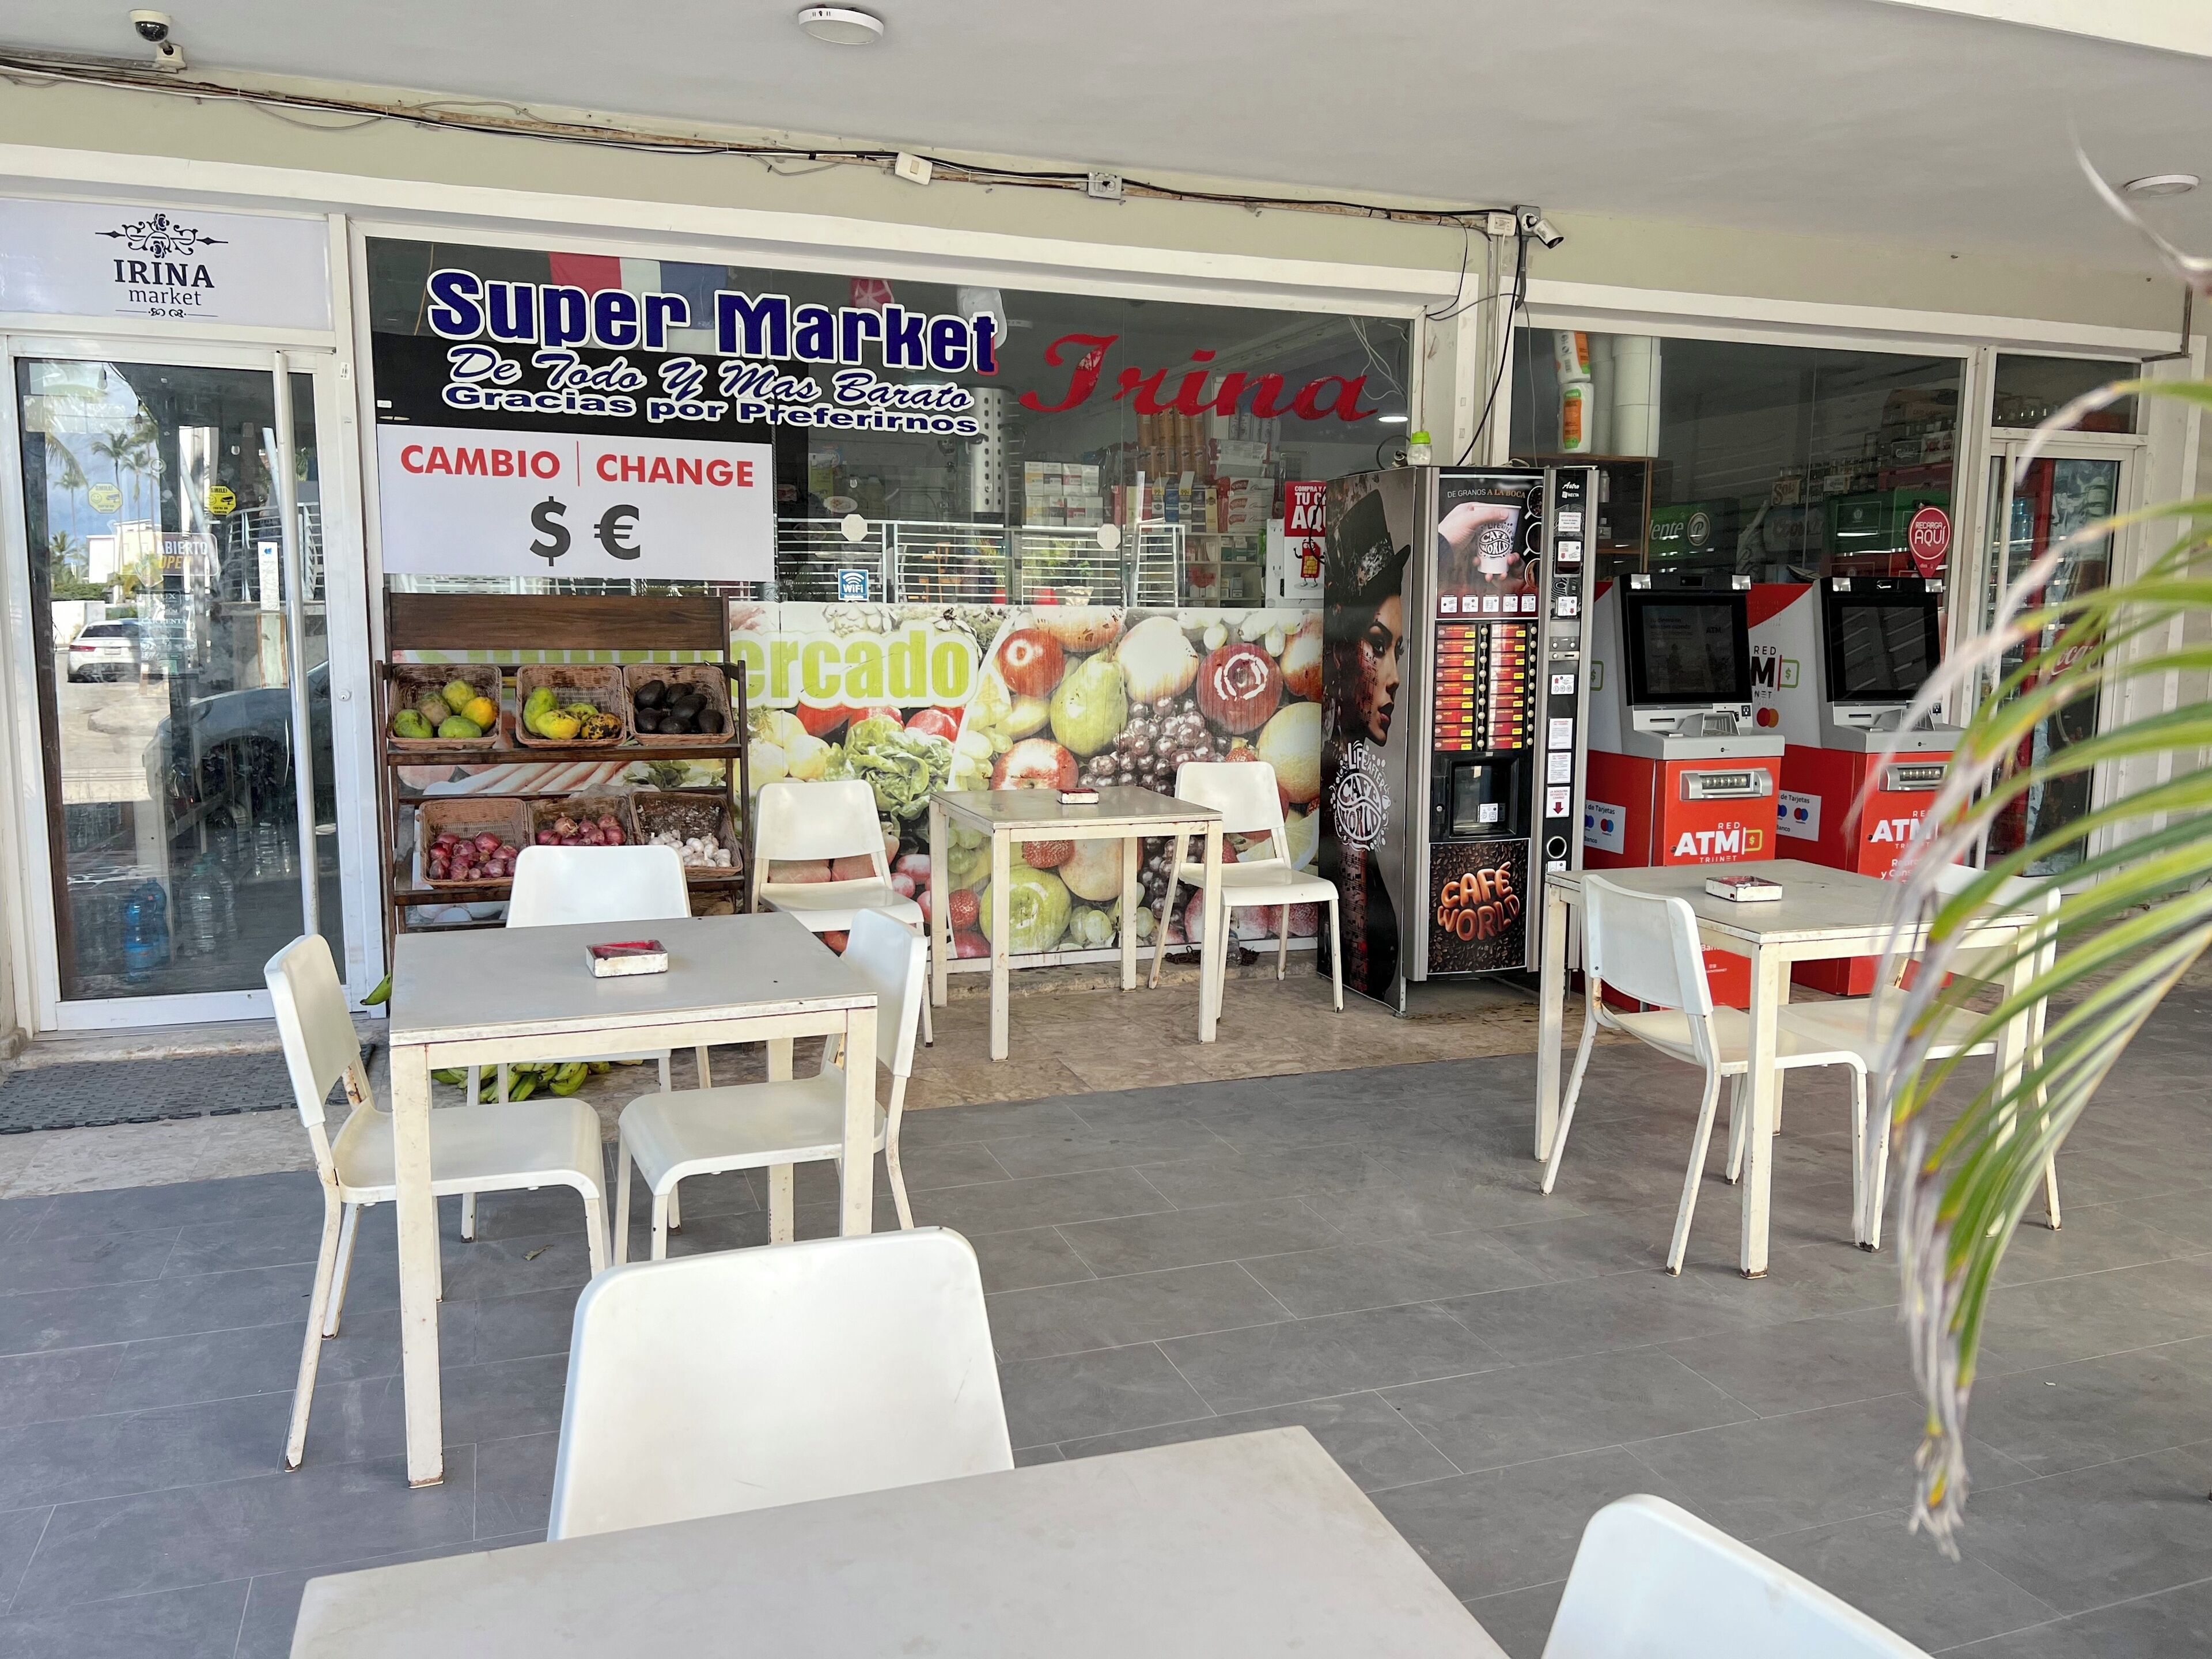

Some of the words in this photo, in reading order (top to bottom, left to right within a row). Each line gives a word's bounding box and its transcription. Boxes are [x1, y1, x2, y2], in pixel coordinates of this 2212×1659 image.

[113, 259, 214, 288] IRINA
[128, 288, 202, 305] market
[429, 270, 689, 350] Super
[716, 291, 997, 374] Market
[449, 346, 520, 383] De
[533, 351, 645, 390] Todo
[660, 358, 706, 401] Y
[720, 362, 820, 399] Mas
[834, 370, 973, 410] Barato
[1018, 334, 1377, 421] Irina
[444, 385, 635, 415] Gracias
[649, 397, 727, 422] por
[738, 402, 977, 435] Preferirnos
[401, 445, 560, 479] CAMBIO
[597, 454, 754, 487] CHANGE
[1295, 492, 1310, 505] TU
[1505, 490, 1526, 498] BOCA
[529, 495, 571, 567] $
[594, 504, 641, 560] €
[1914, 525, 1946, 547] AQUÍ
[157, 540, 208, 555] ABIERTO
[1480, 540, 1510, 554] WORLD
[1753, 645, 1777, 656] RED
[1347, 742, 1369, 771] LIFE
[1366, 763, 1386, 791] AFTER
[1595, 805, 1615, 815] Tarjetas
[1789, 794, 1810, 804] Tarjetas
[1718, 821, 1740, 830] RED
[1673, 830, 1740, 857] ATM
[1441, 861, 1513, 908] CAFÉ
[1437, 894, 1520, 941] WORLD
